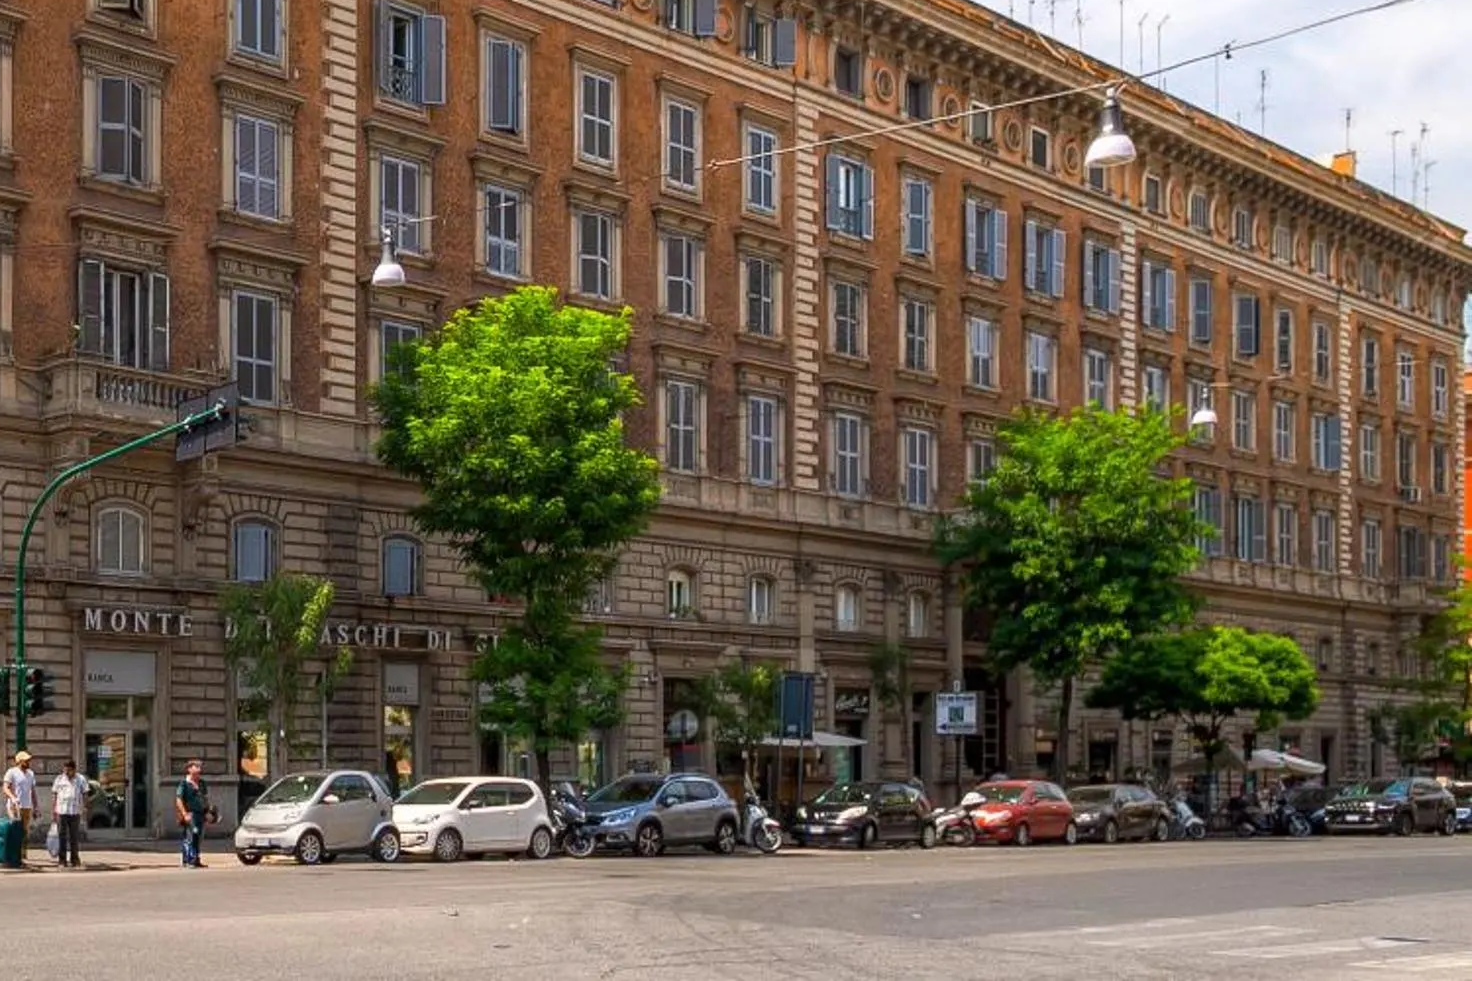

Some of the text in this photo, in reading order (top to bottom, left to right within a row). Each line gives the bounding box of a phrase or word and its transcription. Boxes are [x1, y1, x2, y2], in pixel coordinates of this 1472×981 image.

[84, 607, 194, 637] MONTE
[224, 616, 272, 642] DI
[314, 623, 400, 649] ASCHI
[428, 629, 451, 652] DI
